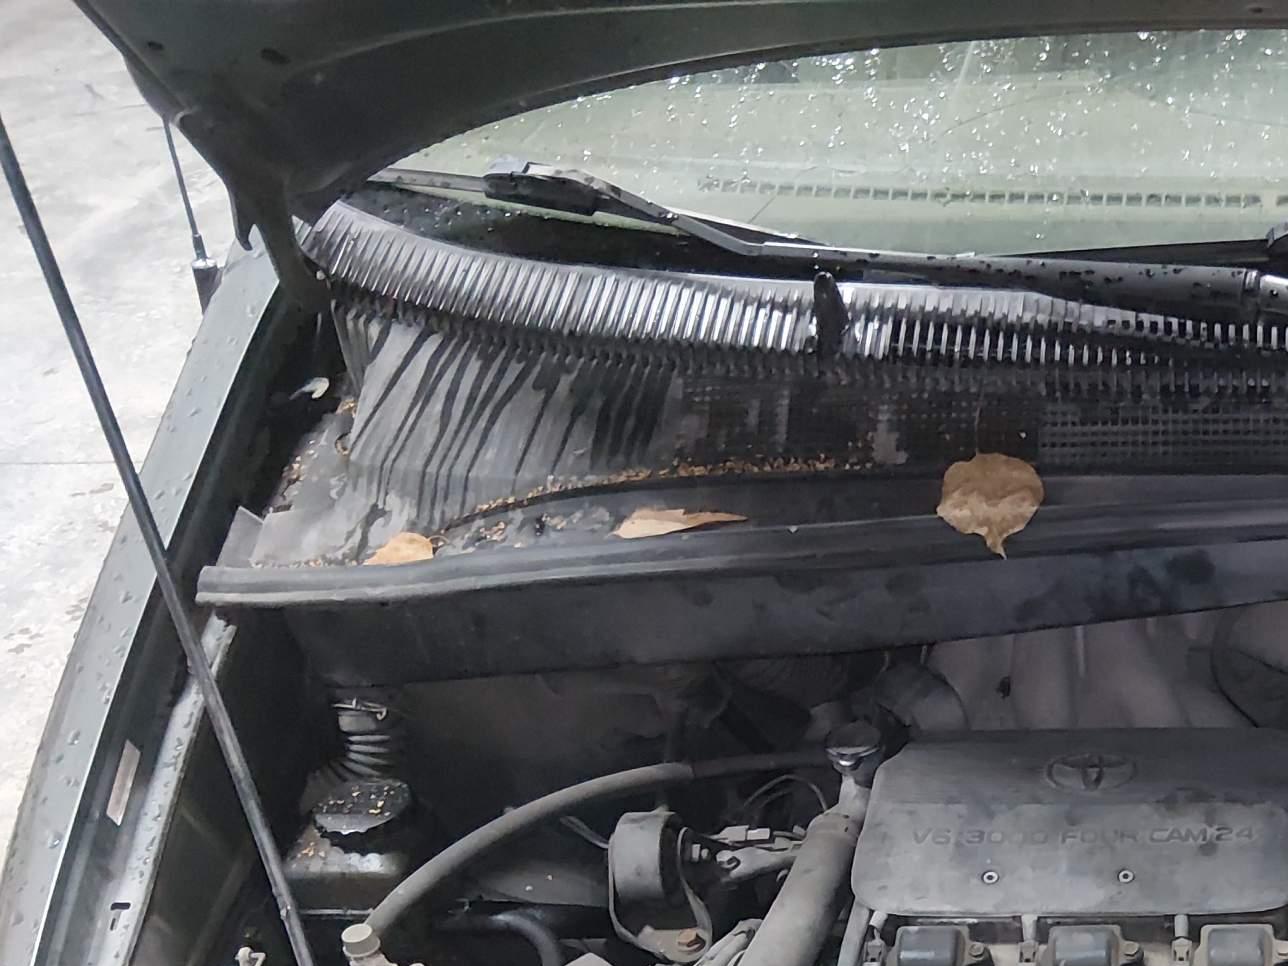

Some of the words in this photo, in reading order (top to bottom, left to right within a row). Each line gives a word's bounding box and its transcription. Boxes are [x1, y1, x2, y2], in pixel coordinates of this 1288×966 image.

[912, 828, 952, 845] V6
[1148, 827, 1208, 843] CAM
[1214, 824, 1254, 842] 24
